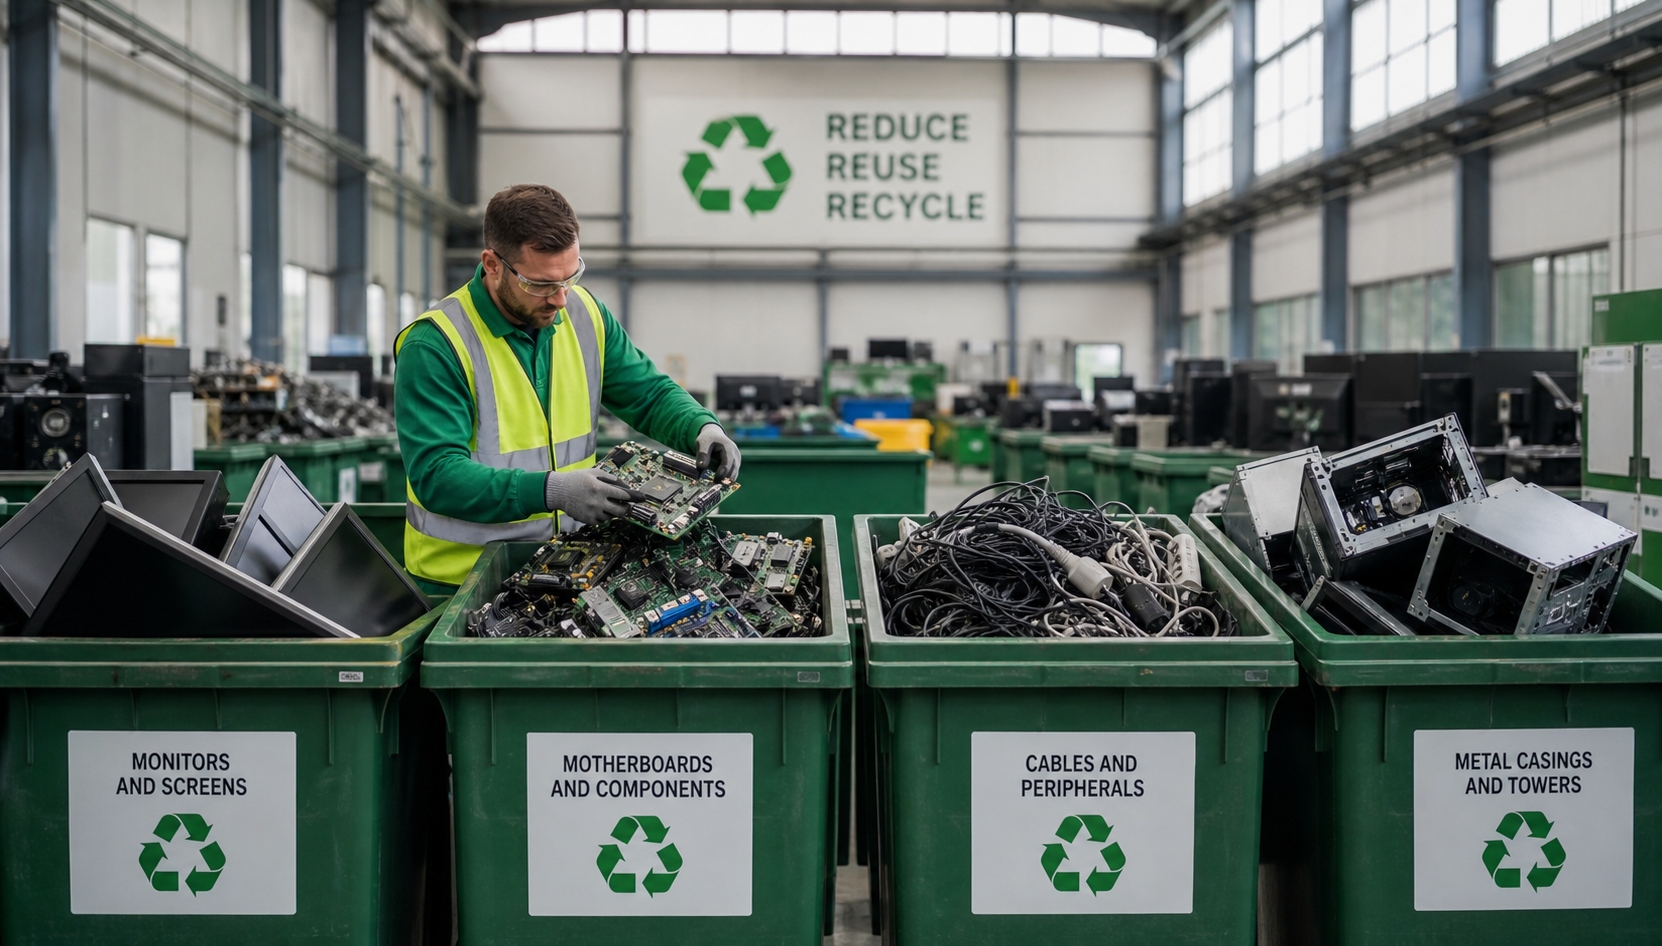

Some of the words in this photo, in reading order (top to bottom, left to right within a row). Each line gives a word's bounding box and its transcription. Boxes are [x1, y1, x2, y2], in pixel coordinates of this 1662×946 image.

[826, 113, 969, 141] REDUCE
[826, 153, 940, 181] REUSE
[826, 193, 984, 220] RECYCLE
[132, 752, 230, 771] MONITORS
[563, 754, 713, 773] MOTHERBOARDS
[1025, 754, 1095, 773] CABLES
[1099, 754, 1138, 773] AND
[1455, 752, 1513, 770] METAL
[1516, 751, 1593, 770] CASINGS
[115, 776, 156, 795] AND
[161, 777, 247, 796] SCREENS
[550, 779, 590, 798] AND
[596, 779, 726, 798] COMPONENTS
[1021, 779, 1145, 798] PERIPHERALS
[1465, 776, 1503, 795] AND
[1507, 775, 1582, 795] TOWERS
